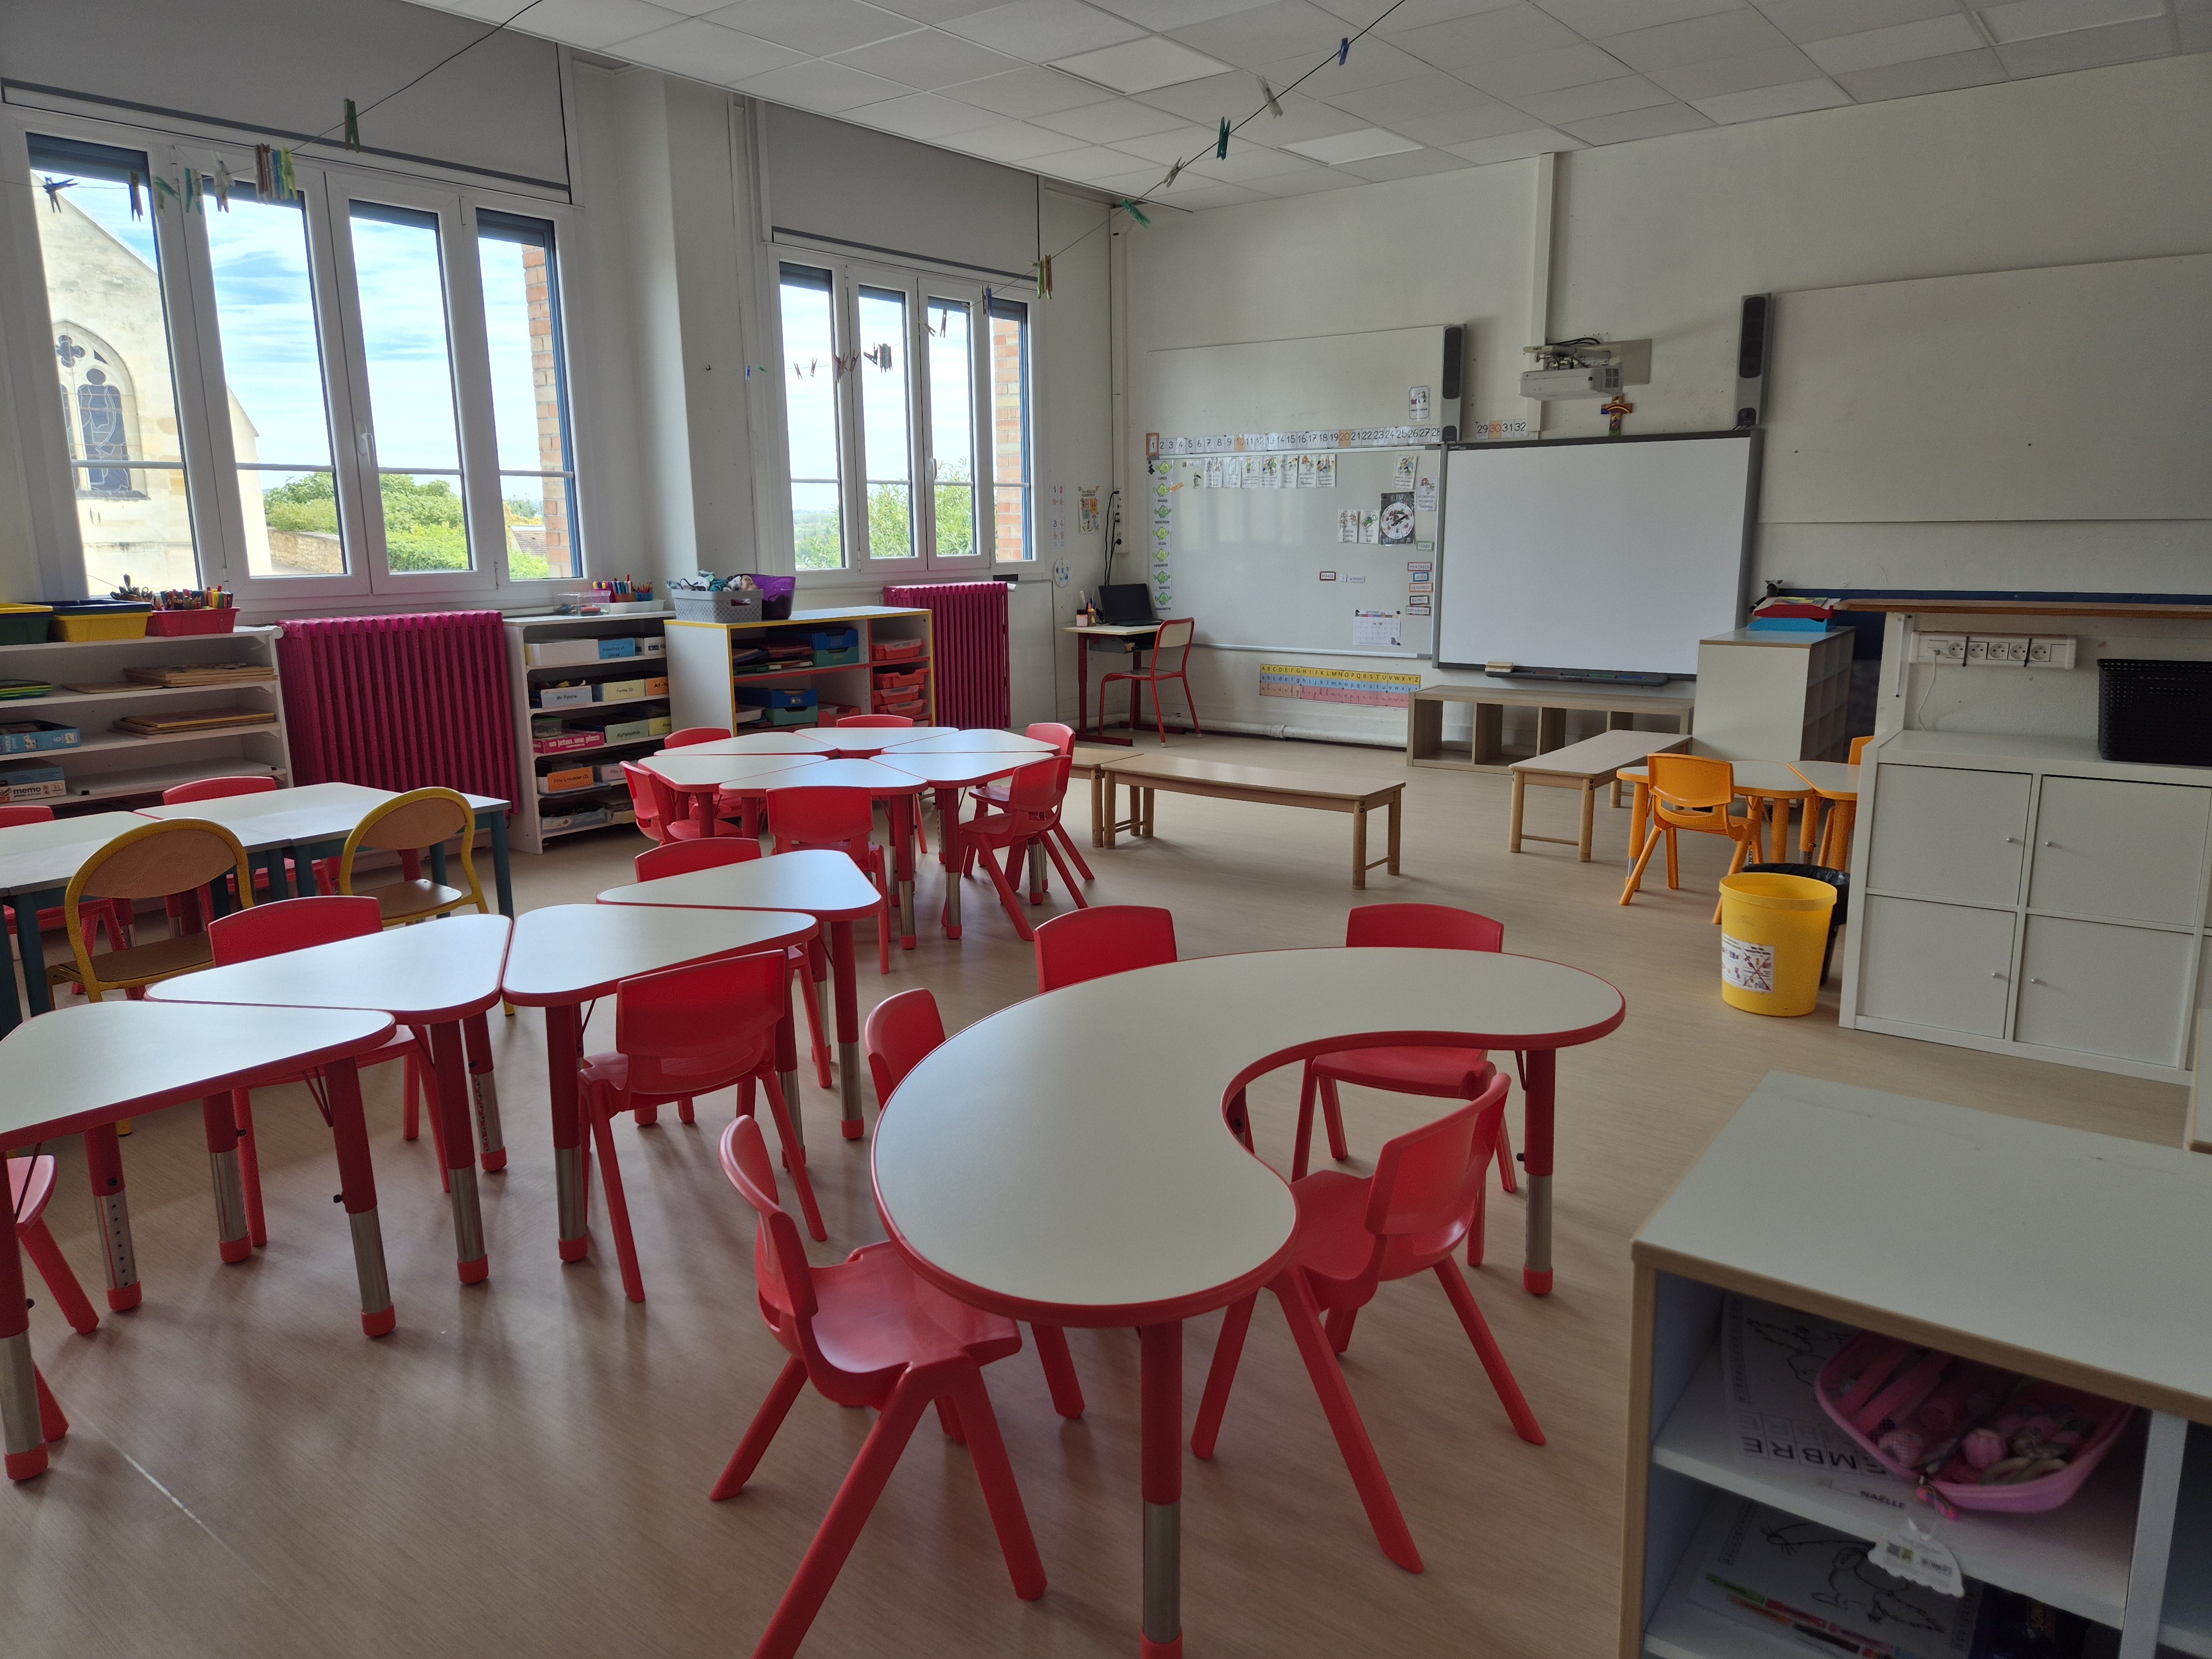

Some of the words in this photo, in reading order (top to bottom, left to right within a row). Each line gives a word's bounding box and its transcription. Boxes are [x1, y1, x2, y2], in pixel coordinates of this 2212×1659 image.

[1160, 441, 1164, 450] 2
[1168, 441, 1173, 449] 3
[1237, 437, 1244, 446] 10
[1246, 437, 1254, 445] 11
[1256, 437, 1265, 445] 12
[1266, 436, 1275, 445] 13
[1287, 435, 1295, 443] 15
[1297, 434, 1306, 442] 16
[1308, 434, 1317, 442] 17
[1330, 432, 1339, 441] 19
[1340, 432, 1350, 441] 20
[1351, 431, 1360, 440] 21
[1362, 431, 1371, 440] 22
[1373, 431, 1384, 440] 23
[1385, 430, 1394, 439] 24
[1396, 430, 1407, 439] 25
[1408, 429, 1418, 438] 26
[1420, 428, 1430, 437] 27
[1431, 427, 1440, 436] 28
[1477, 424, 1488, 434] 29
[1489, 424, 1501, 432] 30
[1503, 423, 1513, 432] 31
[1514, 422, 1526, 431] 32
[617, 729, 640, 738] Autonomie
[586, 735, 600, 744] place
